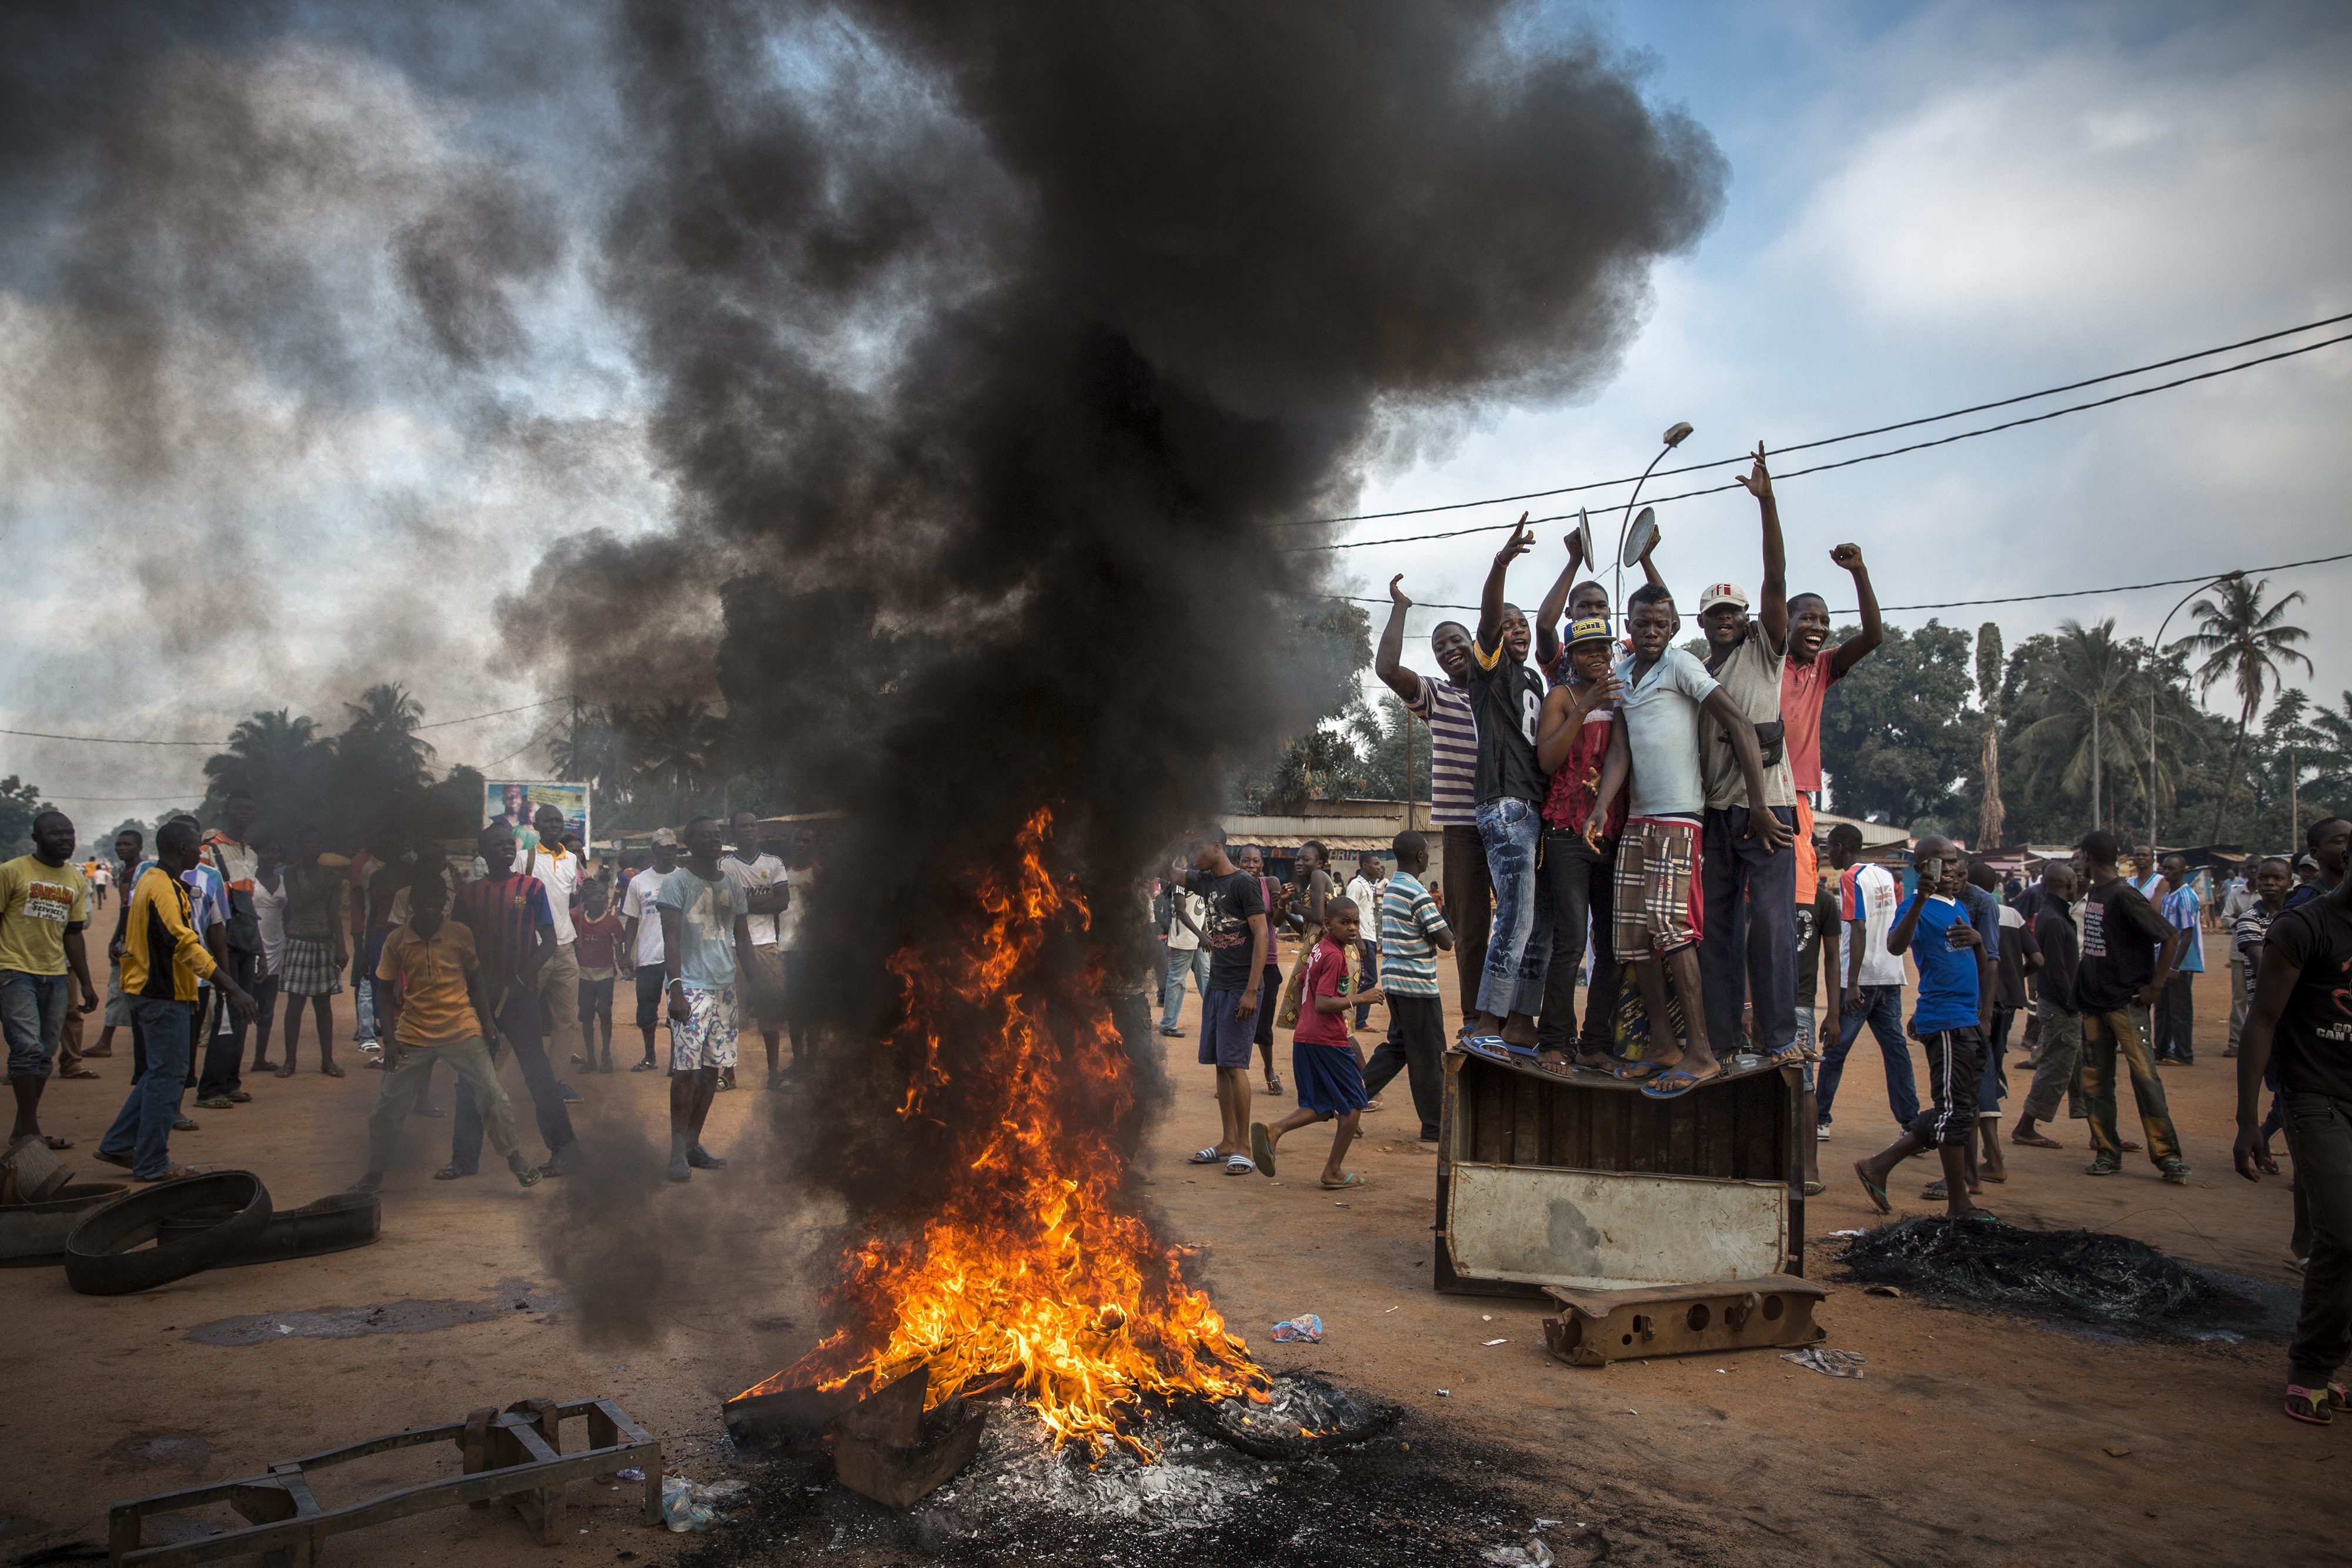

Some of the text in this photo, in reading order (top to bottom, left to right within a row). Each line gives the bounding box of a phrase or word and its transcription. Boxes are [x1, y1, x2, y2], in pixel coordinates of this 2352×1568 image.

[1711, 583, 1731, 599] rfi
[1329, 850, 1359, 861] ARIM
[2316, 1028, 2345, 1041] CAN
